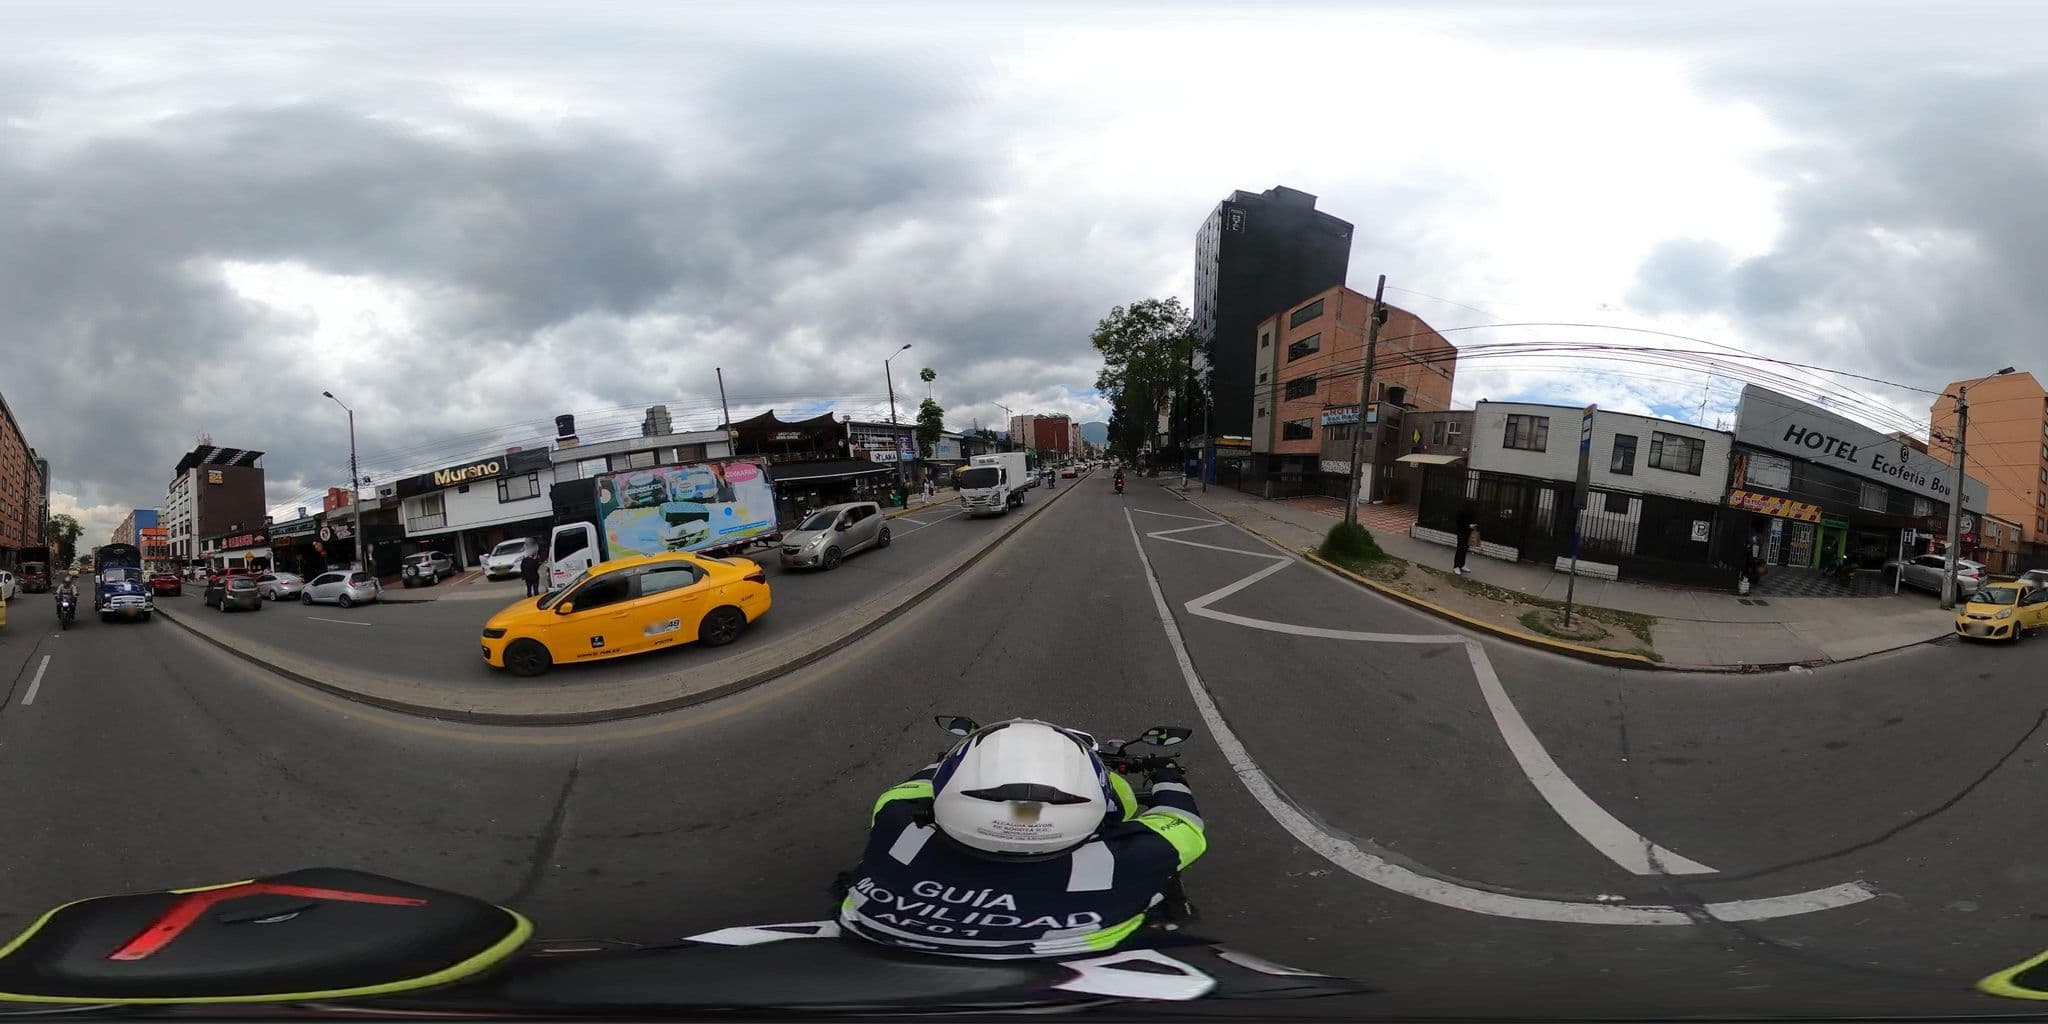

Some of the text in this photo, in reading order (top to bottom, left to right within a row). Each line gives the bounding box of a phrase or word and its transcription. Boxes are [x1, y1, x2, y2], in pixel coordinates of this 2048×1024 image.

[1330, 406, 1361, 415] HOTE
[1783, 424, 1858, 463] HOTEL
[434, 461, 500, 486] Murano
[1871, 453, 1925, 487] Ecoferia
[1903, 531, 1912, 542] H
[857, 877, 1103, 928] MOVILIDAD
[912, 880, 1017, 911] GUÍA
